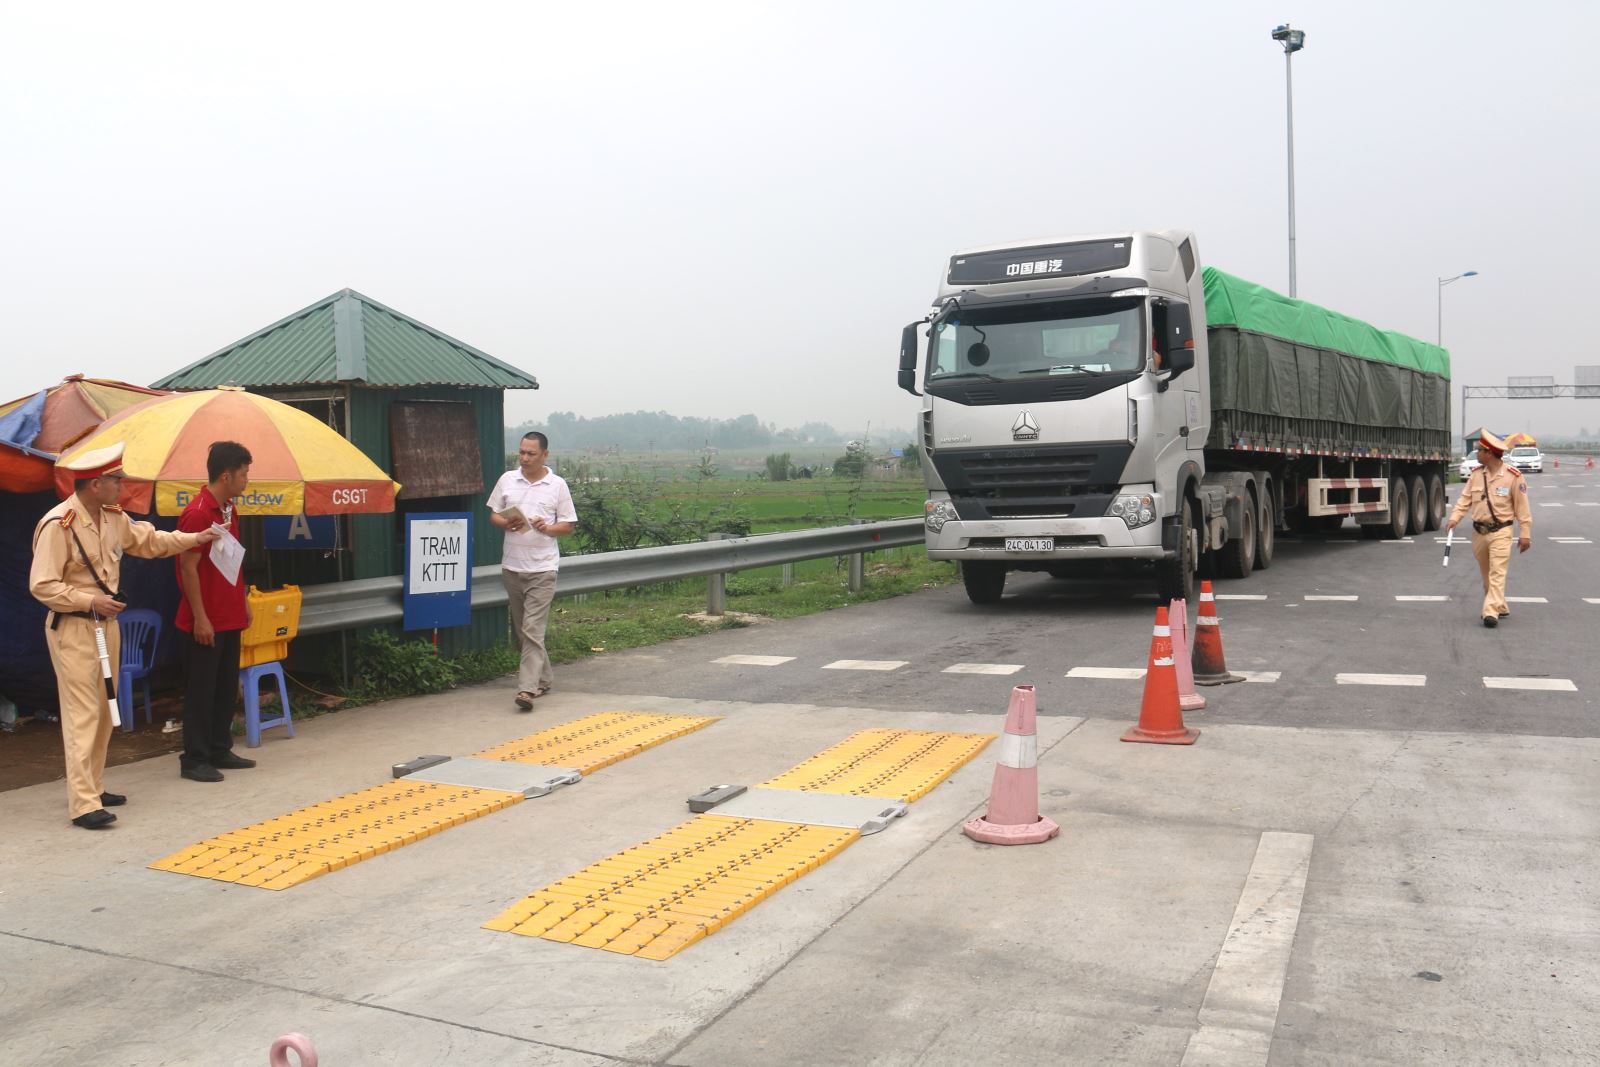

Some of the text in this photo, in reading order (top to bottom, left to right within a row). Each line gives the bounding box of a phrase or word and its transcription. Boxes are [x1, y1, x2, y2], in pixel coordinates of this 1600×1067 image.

[1006, 259, 1063, 276] 中国重汽
[332, 489, 368, 505] CSGT
[288, 514, 312, 540] A
[420, 536, 460, 557] TRẠM
[422, 562, 458, 582] KTTT
